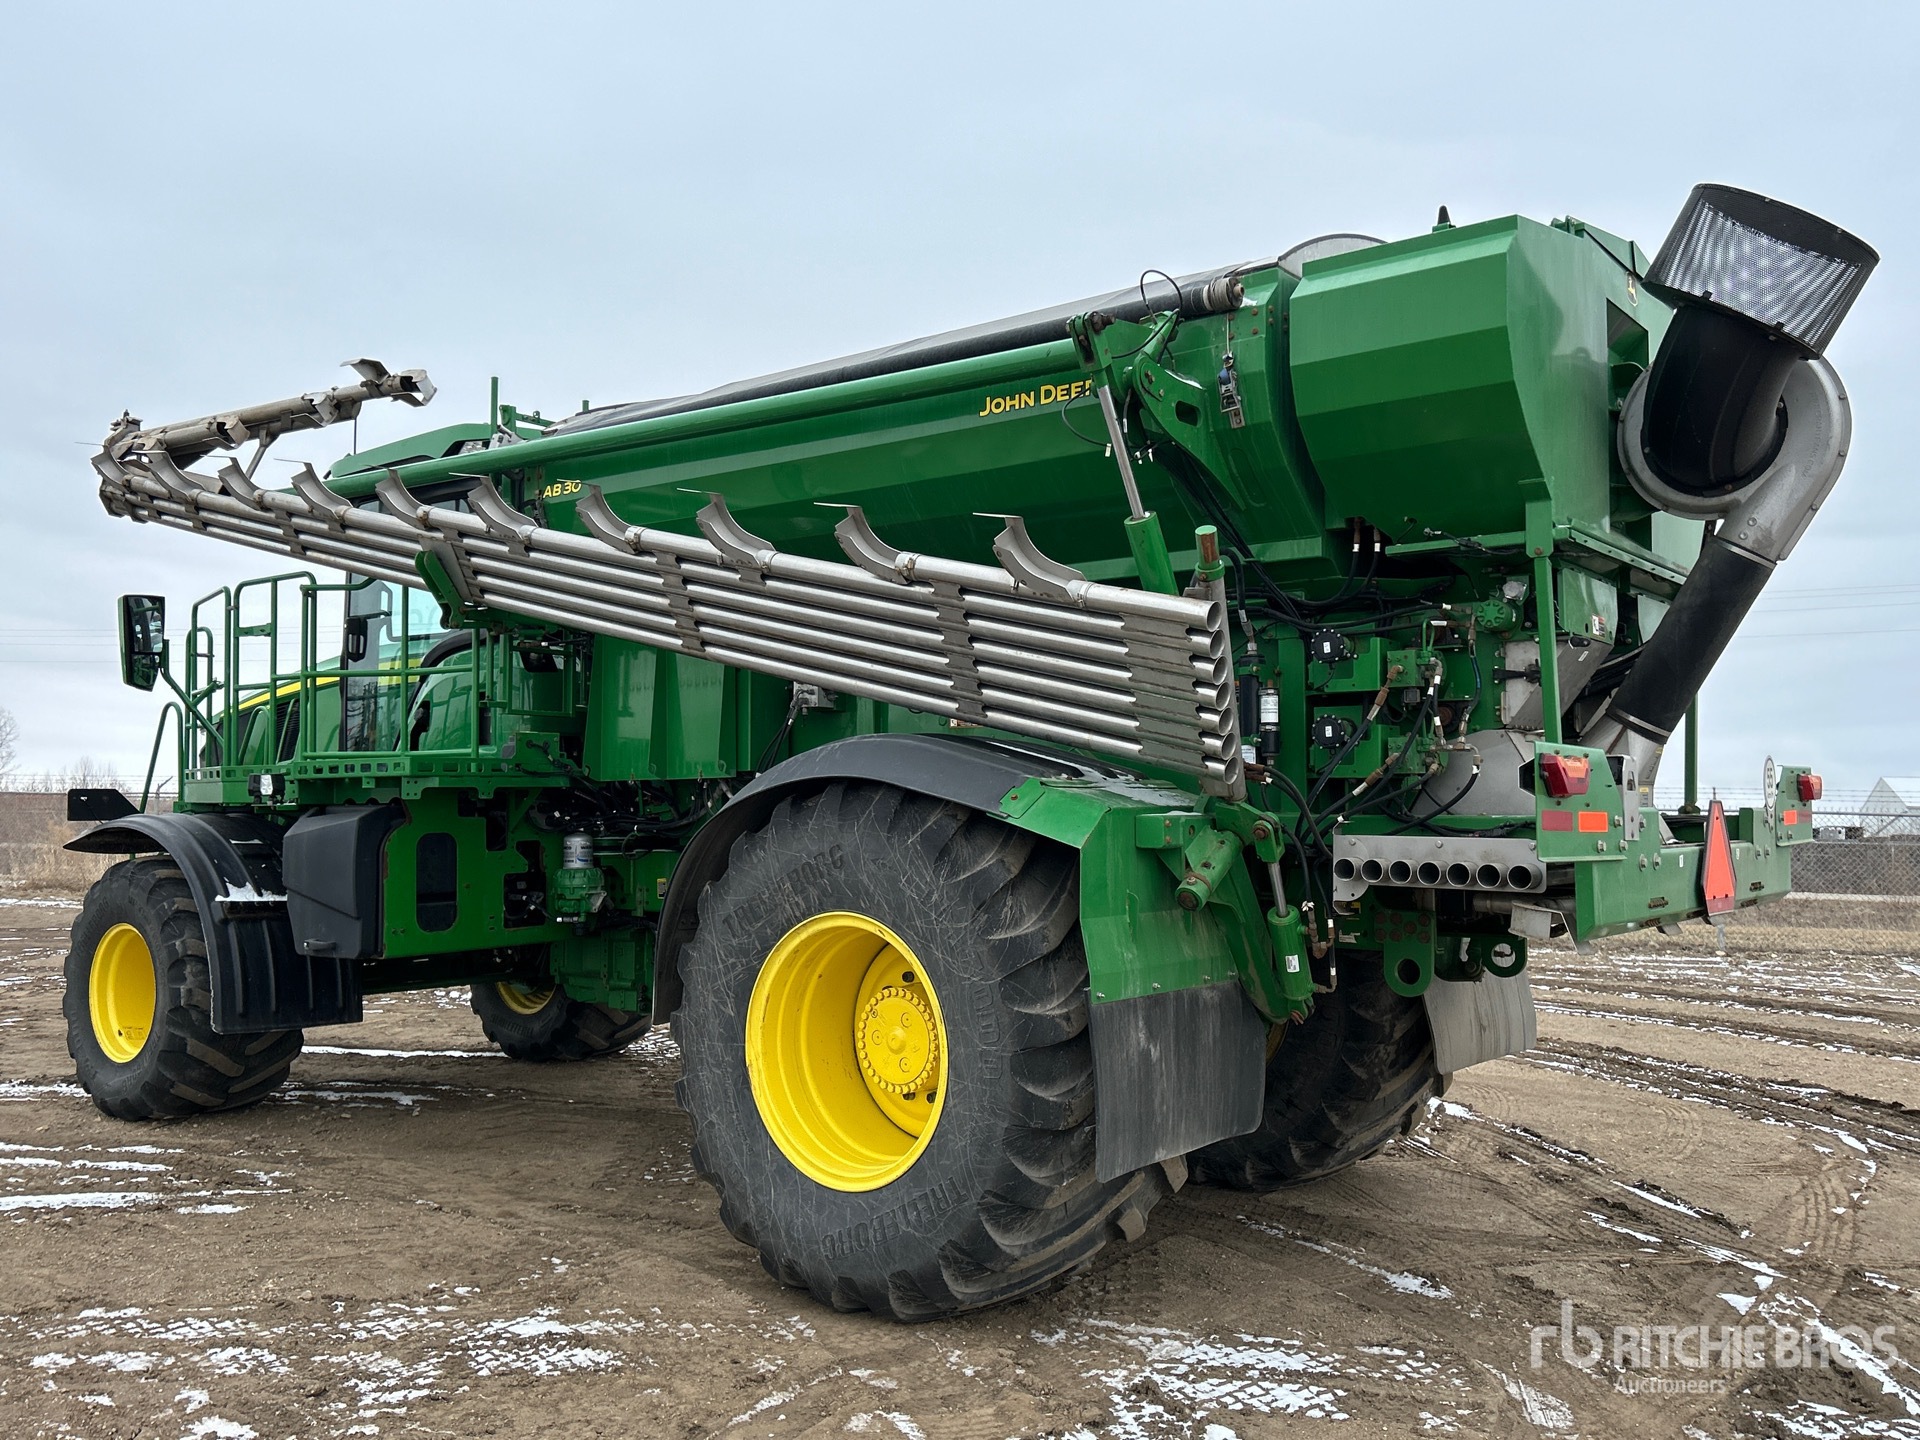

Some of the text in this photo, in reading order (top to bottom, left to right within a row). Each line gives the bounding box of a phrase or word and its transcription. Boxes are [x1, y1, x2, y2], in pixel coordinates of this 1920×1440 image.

[979, 379, 1092, 417] JOHN DEE
[543, 480, 582, 498] AB 30
[821, 1176, 970, 1261] TRELLEBORG
